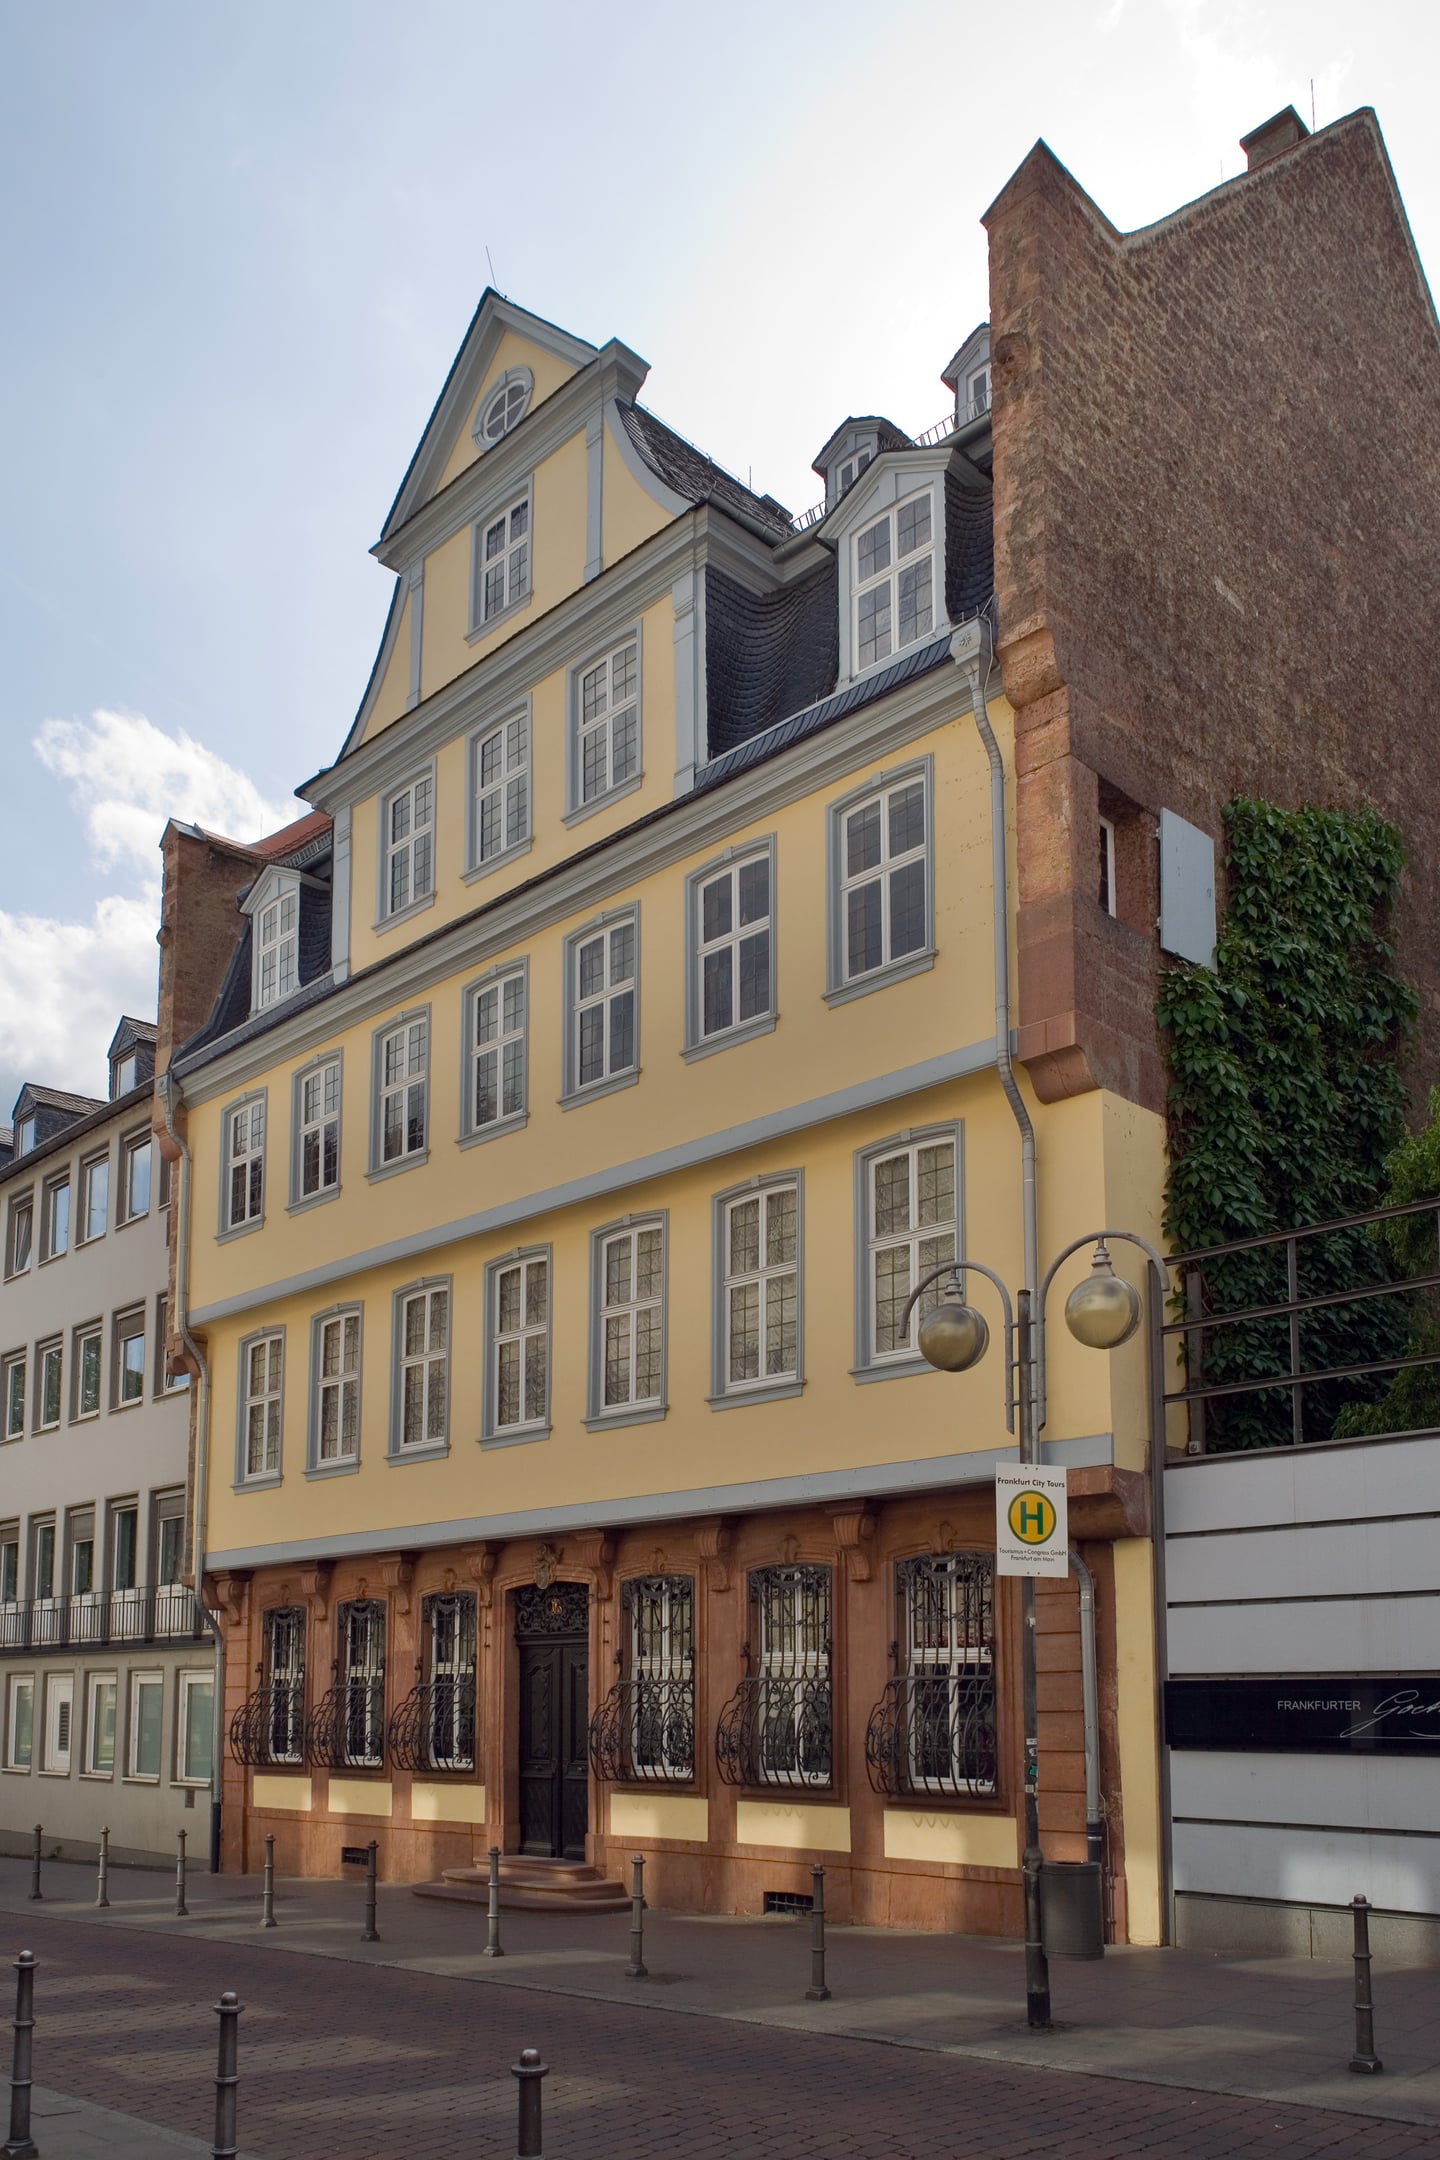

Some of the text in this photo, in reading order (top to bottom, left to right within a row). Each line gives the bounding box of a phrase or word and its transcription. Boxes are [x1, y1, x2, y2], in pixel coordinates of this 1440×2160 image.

[997, 1477, 1065, 1488] Frankfurt City Tours
[1020, 1501, 1044, 1535] H
[1277, 1700, 1361, 1711] FRANKFURTER
